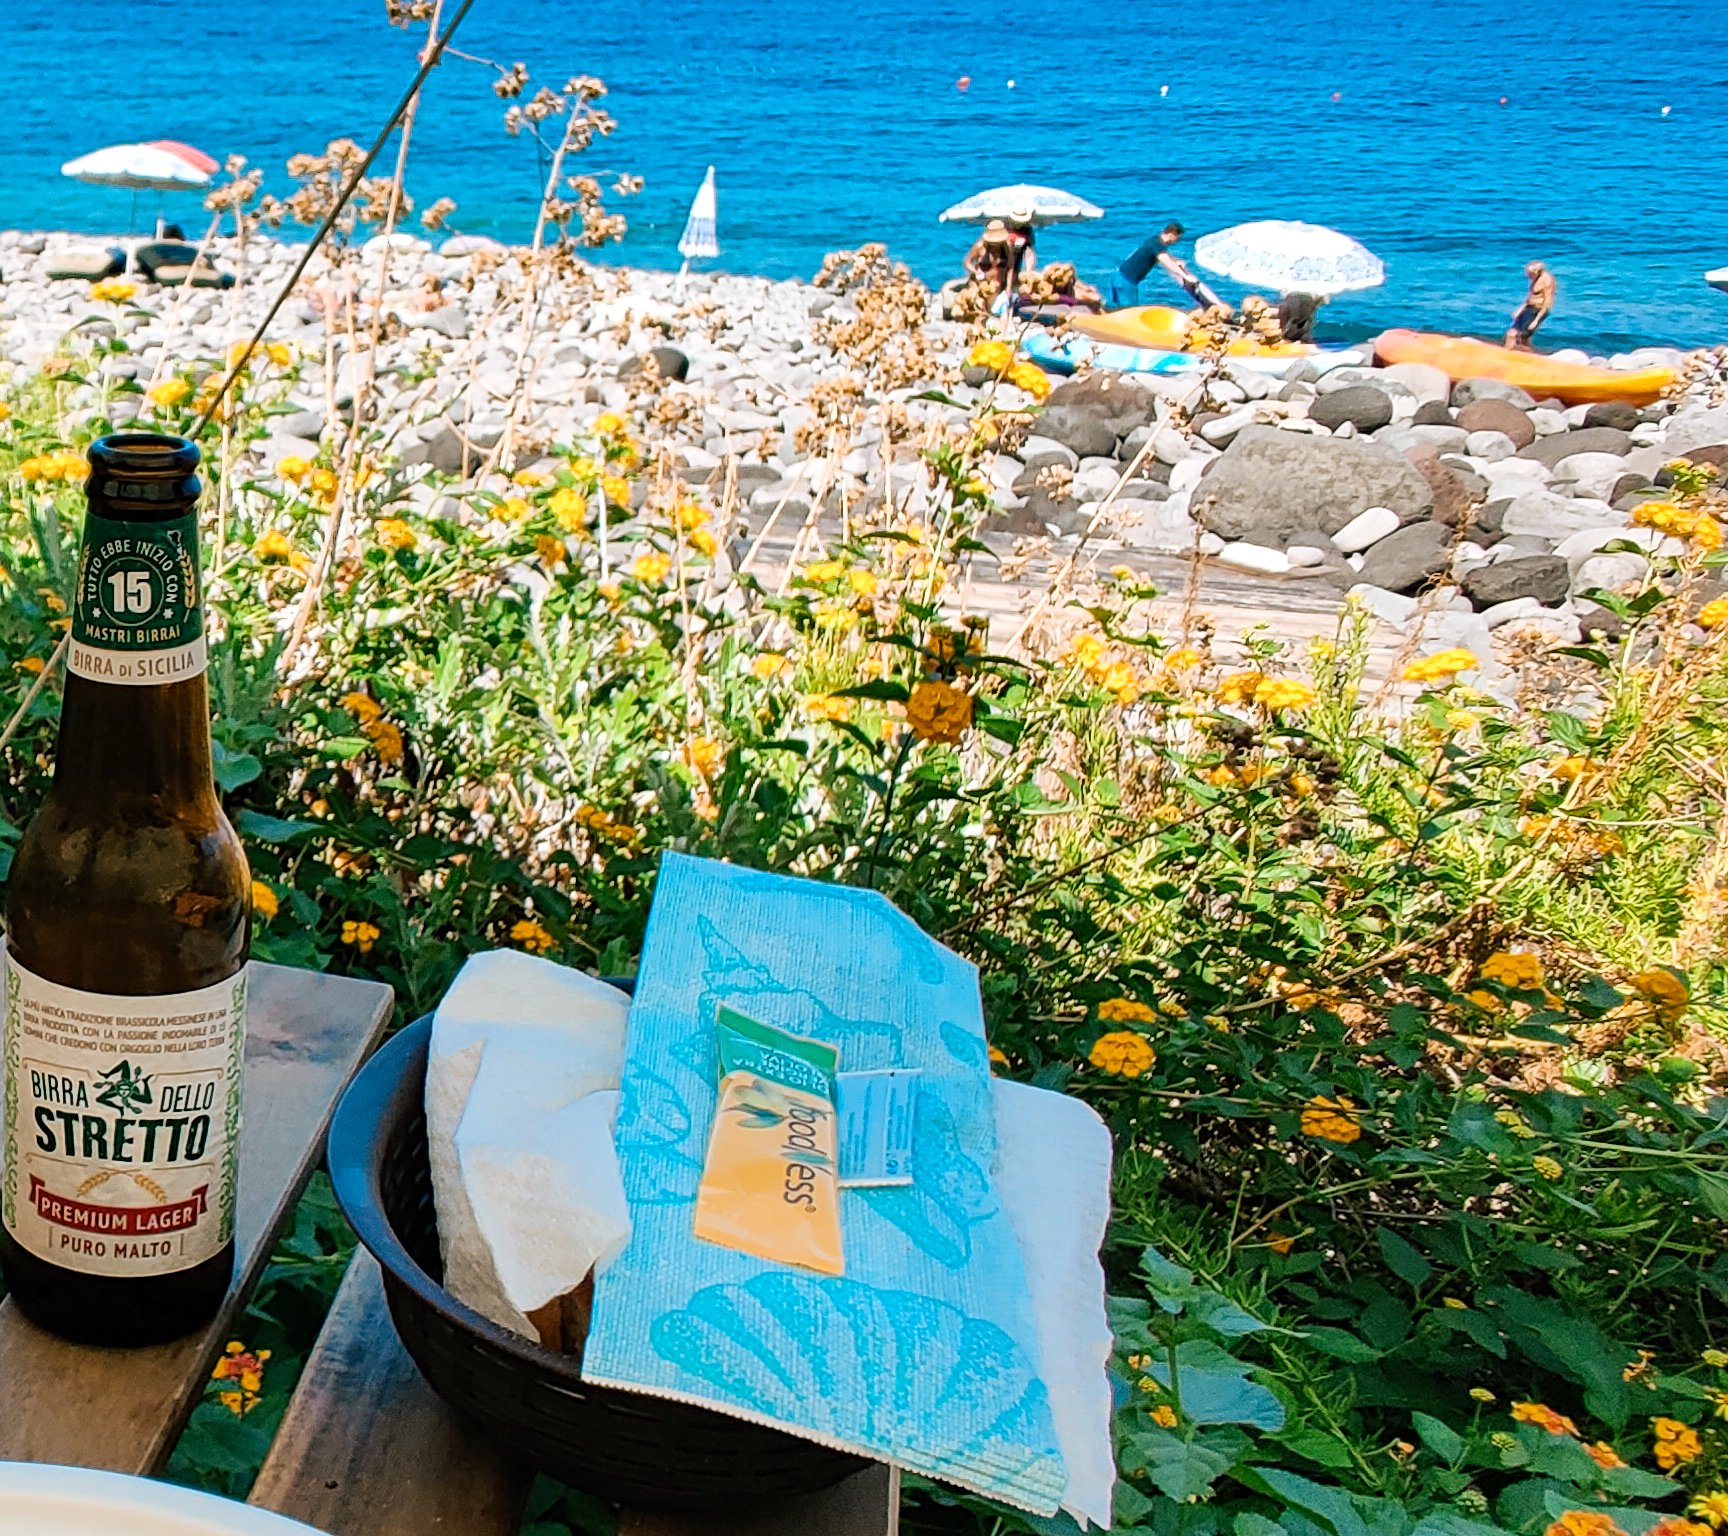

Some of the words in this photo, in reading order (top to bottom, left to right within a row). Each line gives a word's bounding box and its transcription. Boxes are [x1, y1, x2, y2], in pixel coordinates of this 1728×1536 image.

[88, 557, 102, 601] TUTTO
[100, 539, 131, 559] EBBE
[136, 541, 174, 572] INIZIO
[165, 574, 178, 603] CON
[107, 571, 152, 614] 15
[85, 623, 131, 643] MASTRI
[136, 624, 181, 643] BIRRAI
[73, 650, 114, 676] BIRRA
[137, 651, 195, 677] SICILIA
[60, 1036, 97, 1051] CREDONO
[100, 1042, 117, 1052] CON
[120, 1044, 162, 1054] ORGOGLIO
[82, 1027, 100, 1038] CON
[104, 1029, 114, 1039] LA
[118, 1030, 158, 1040] PASSIONE
[30, 1069, 90, 1108] BIRRA
[159, 1081, 216, 1113] DELLO
[34, 1105, 211, 1163] STRETTO
[41, 1196, 127, 1230] PREMIUM
[136, 1206, 194, 1231] LAGER
[61, 1233, 107, 1257] PURO
[114, 1240, 172, 1259] MALTO
